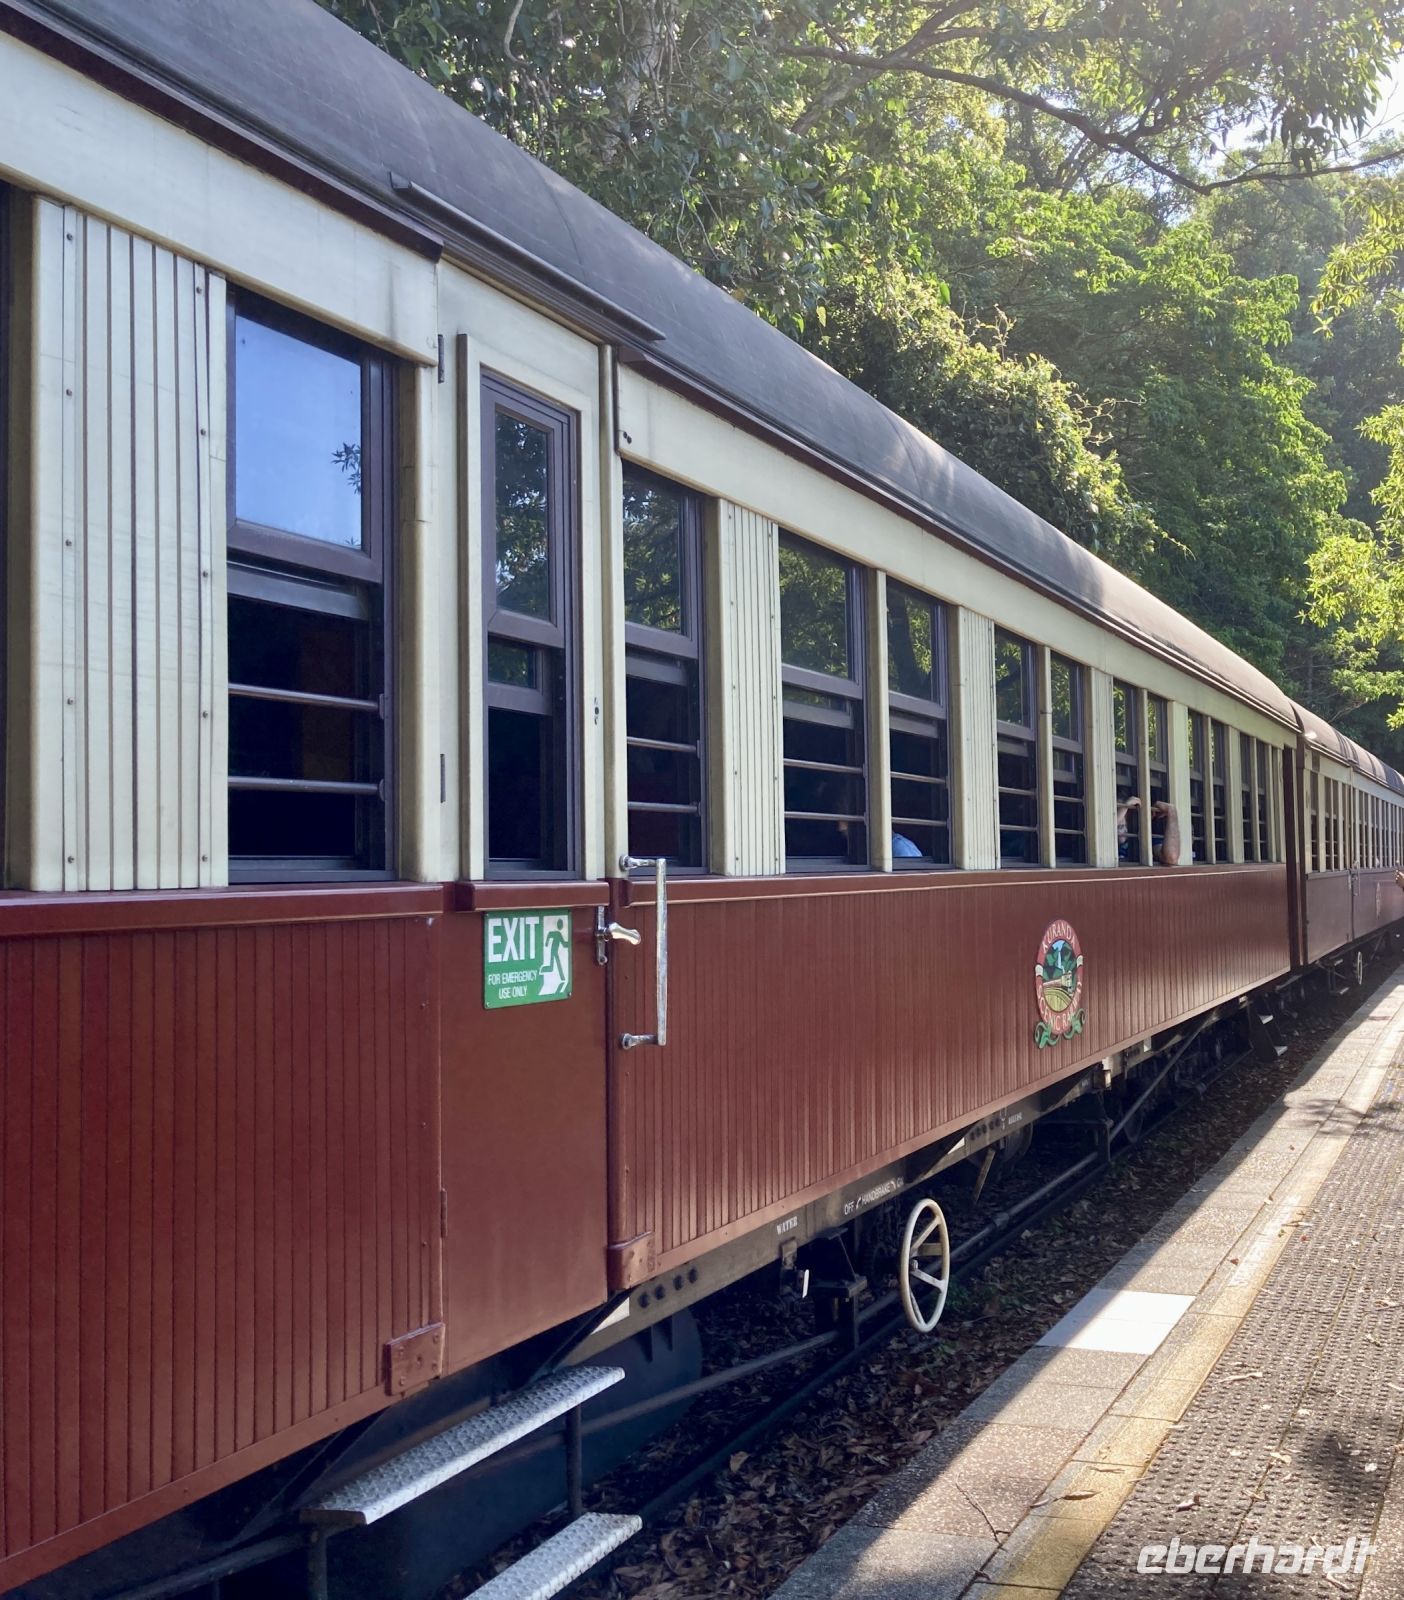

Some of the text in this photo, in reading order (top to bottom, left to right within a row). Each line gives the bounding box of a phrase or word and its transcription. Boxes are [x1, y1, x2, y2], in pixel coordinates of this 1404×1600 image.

[488, 916, 540, 963] EXIT
[1042, 923, 1076, 953] KURANDA
[488, 970, 537, 985] FOR EMERGENCY
[499, 985, 528, 999] USE ONLY
[844, 1201, 854, 1216] OFF
[861, 1183, 891, 1205] HANDBRAKE
[776, 1215, 798, 1235] WATER
